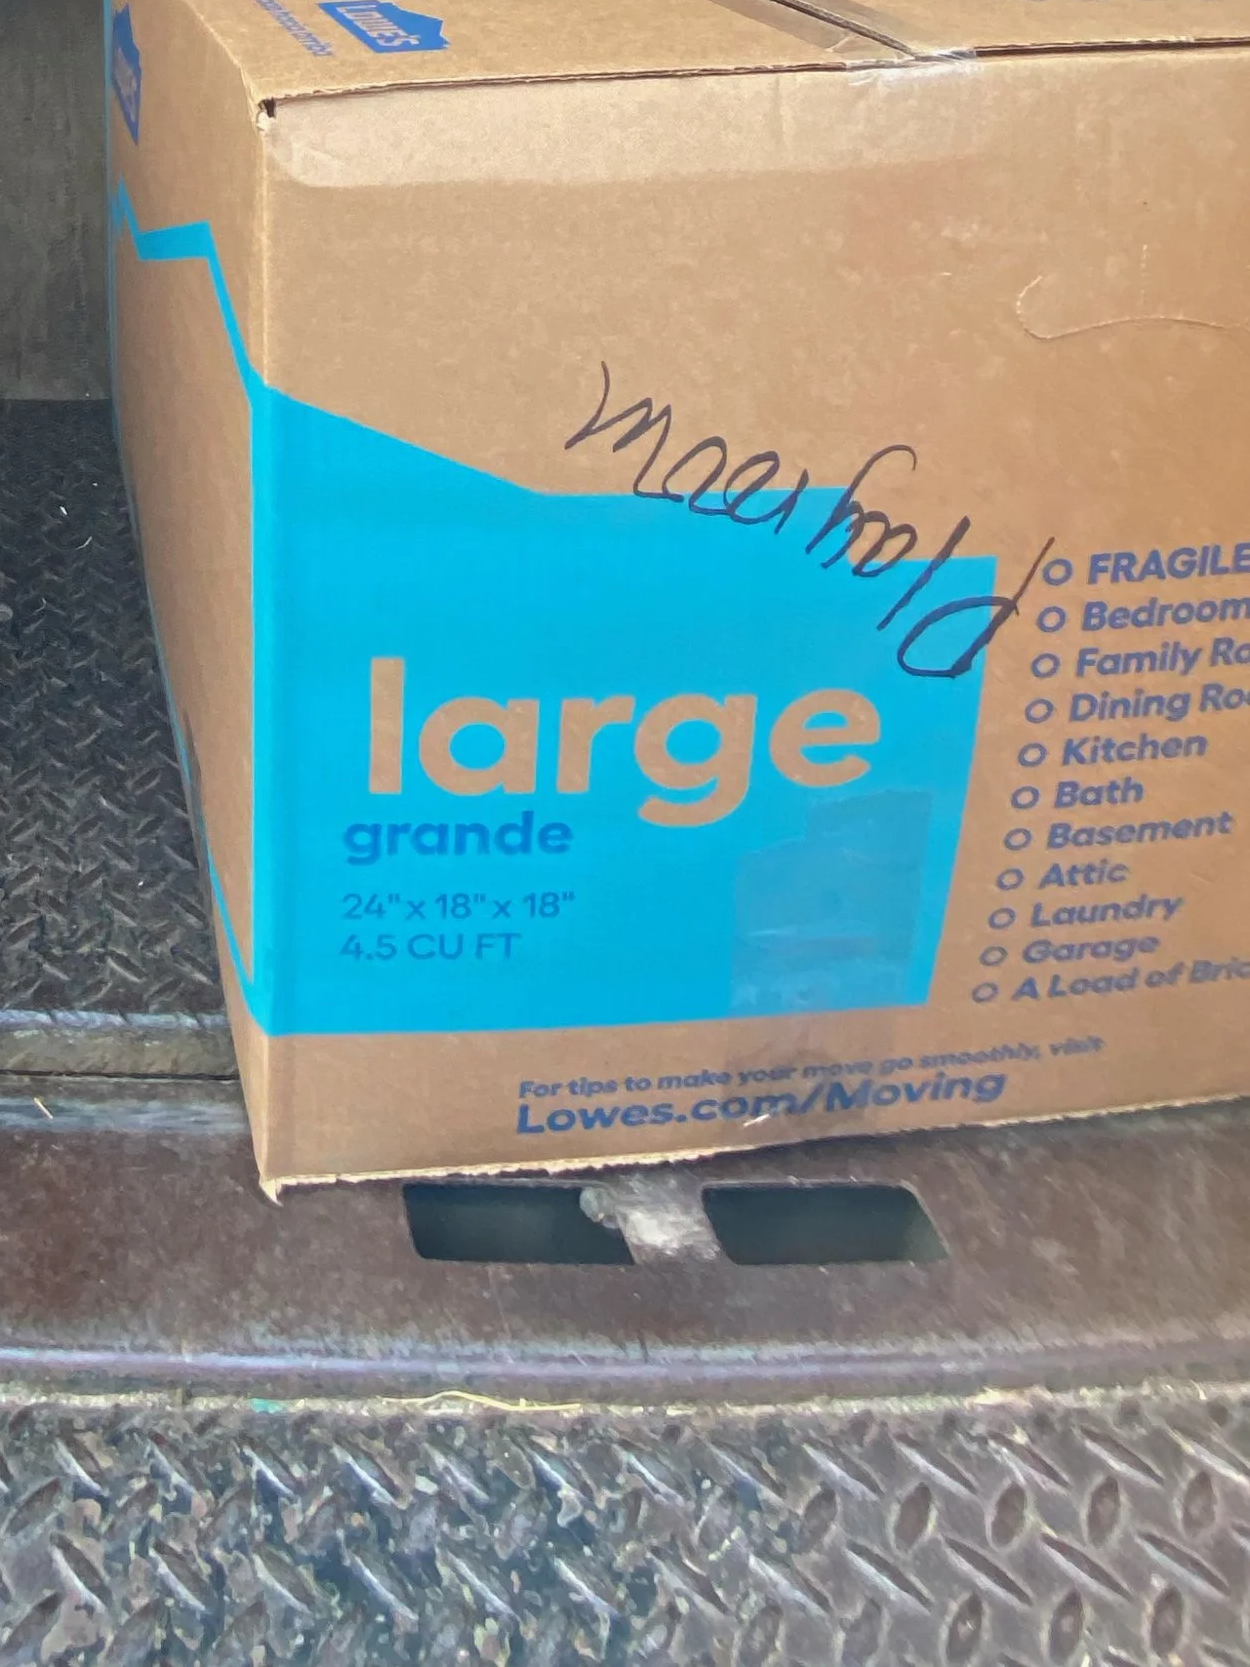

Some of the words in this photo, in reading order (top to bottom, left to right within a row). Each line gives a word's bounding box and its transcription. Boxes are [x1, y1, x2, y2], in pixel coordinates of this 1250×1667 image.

[564, 360, 1055, 679] Playroom
[1087, 542, 1250, 585] FRAGILE
[1081, 597, 1250, 631] Bedroom
[1076, 641, 1203, 677] Family
[1069, 687, 1191, 722] Dining
[368, 656, 882, 827] large
[1061, 733, 1208, 766] Kitchen
[1054, 776, 1144, 809] Bath
[343, 810, 575, 866] grande
[1046, 811, 1235, 850] Basement
[1038, 859, 1130, 890] Attic
[405, 899, 427, 921] x
[492, 899, 512, 919] x
[523, 890, 575, 919] 18"
[1030, 894, 1184, 927] Laundry
[339, 934, 397, 961] 4.5
[407, 933, 464, 960] CU
[474, 932, 522, 960] FT
[1022, 936, 1160, 963] Garage
[1011, 976, 1040, 1001] A
[1047, 967, 1139, 998] Load
[1145, 961, 1185, 989] of
[518, 1078, 563, 1099] For
[568, 1076, 618, 1097] tips
[624, 1076, 652, 1092] to
[657, 1069, 733, 1090] make
[738, 1065, 797, 1086] your
[802, 1060, 873, 1079] move
[880, 1057, 913, 1076] go
[516, 1071, 1006, 1135] Lowes.com/Moving
